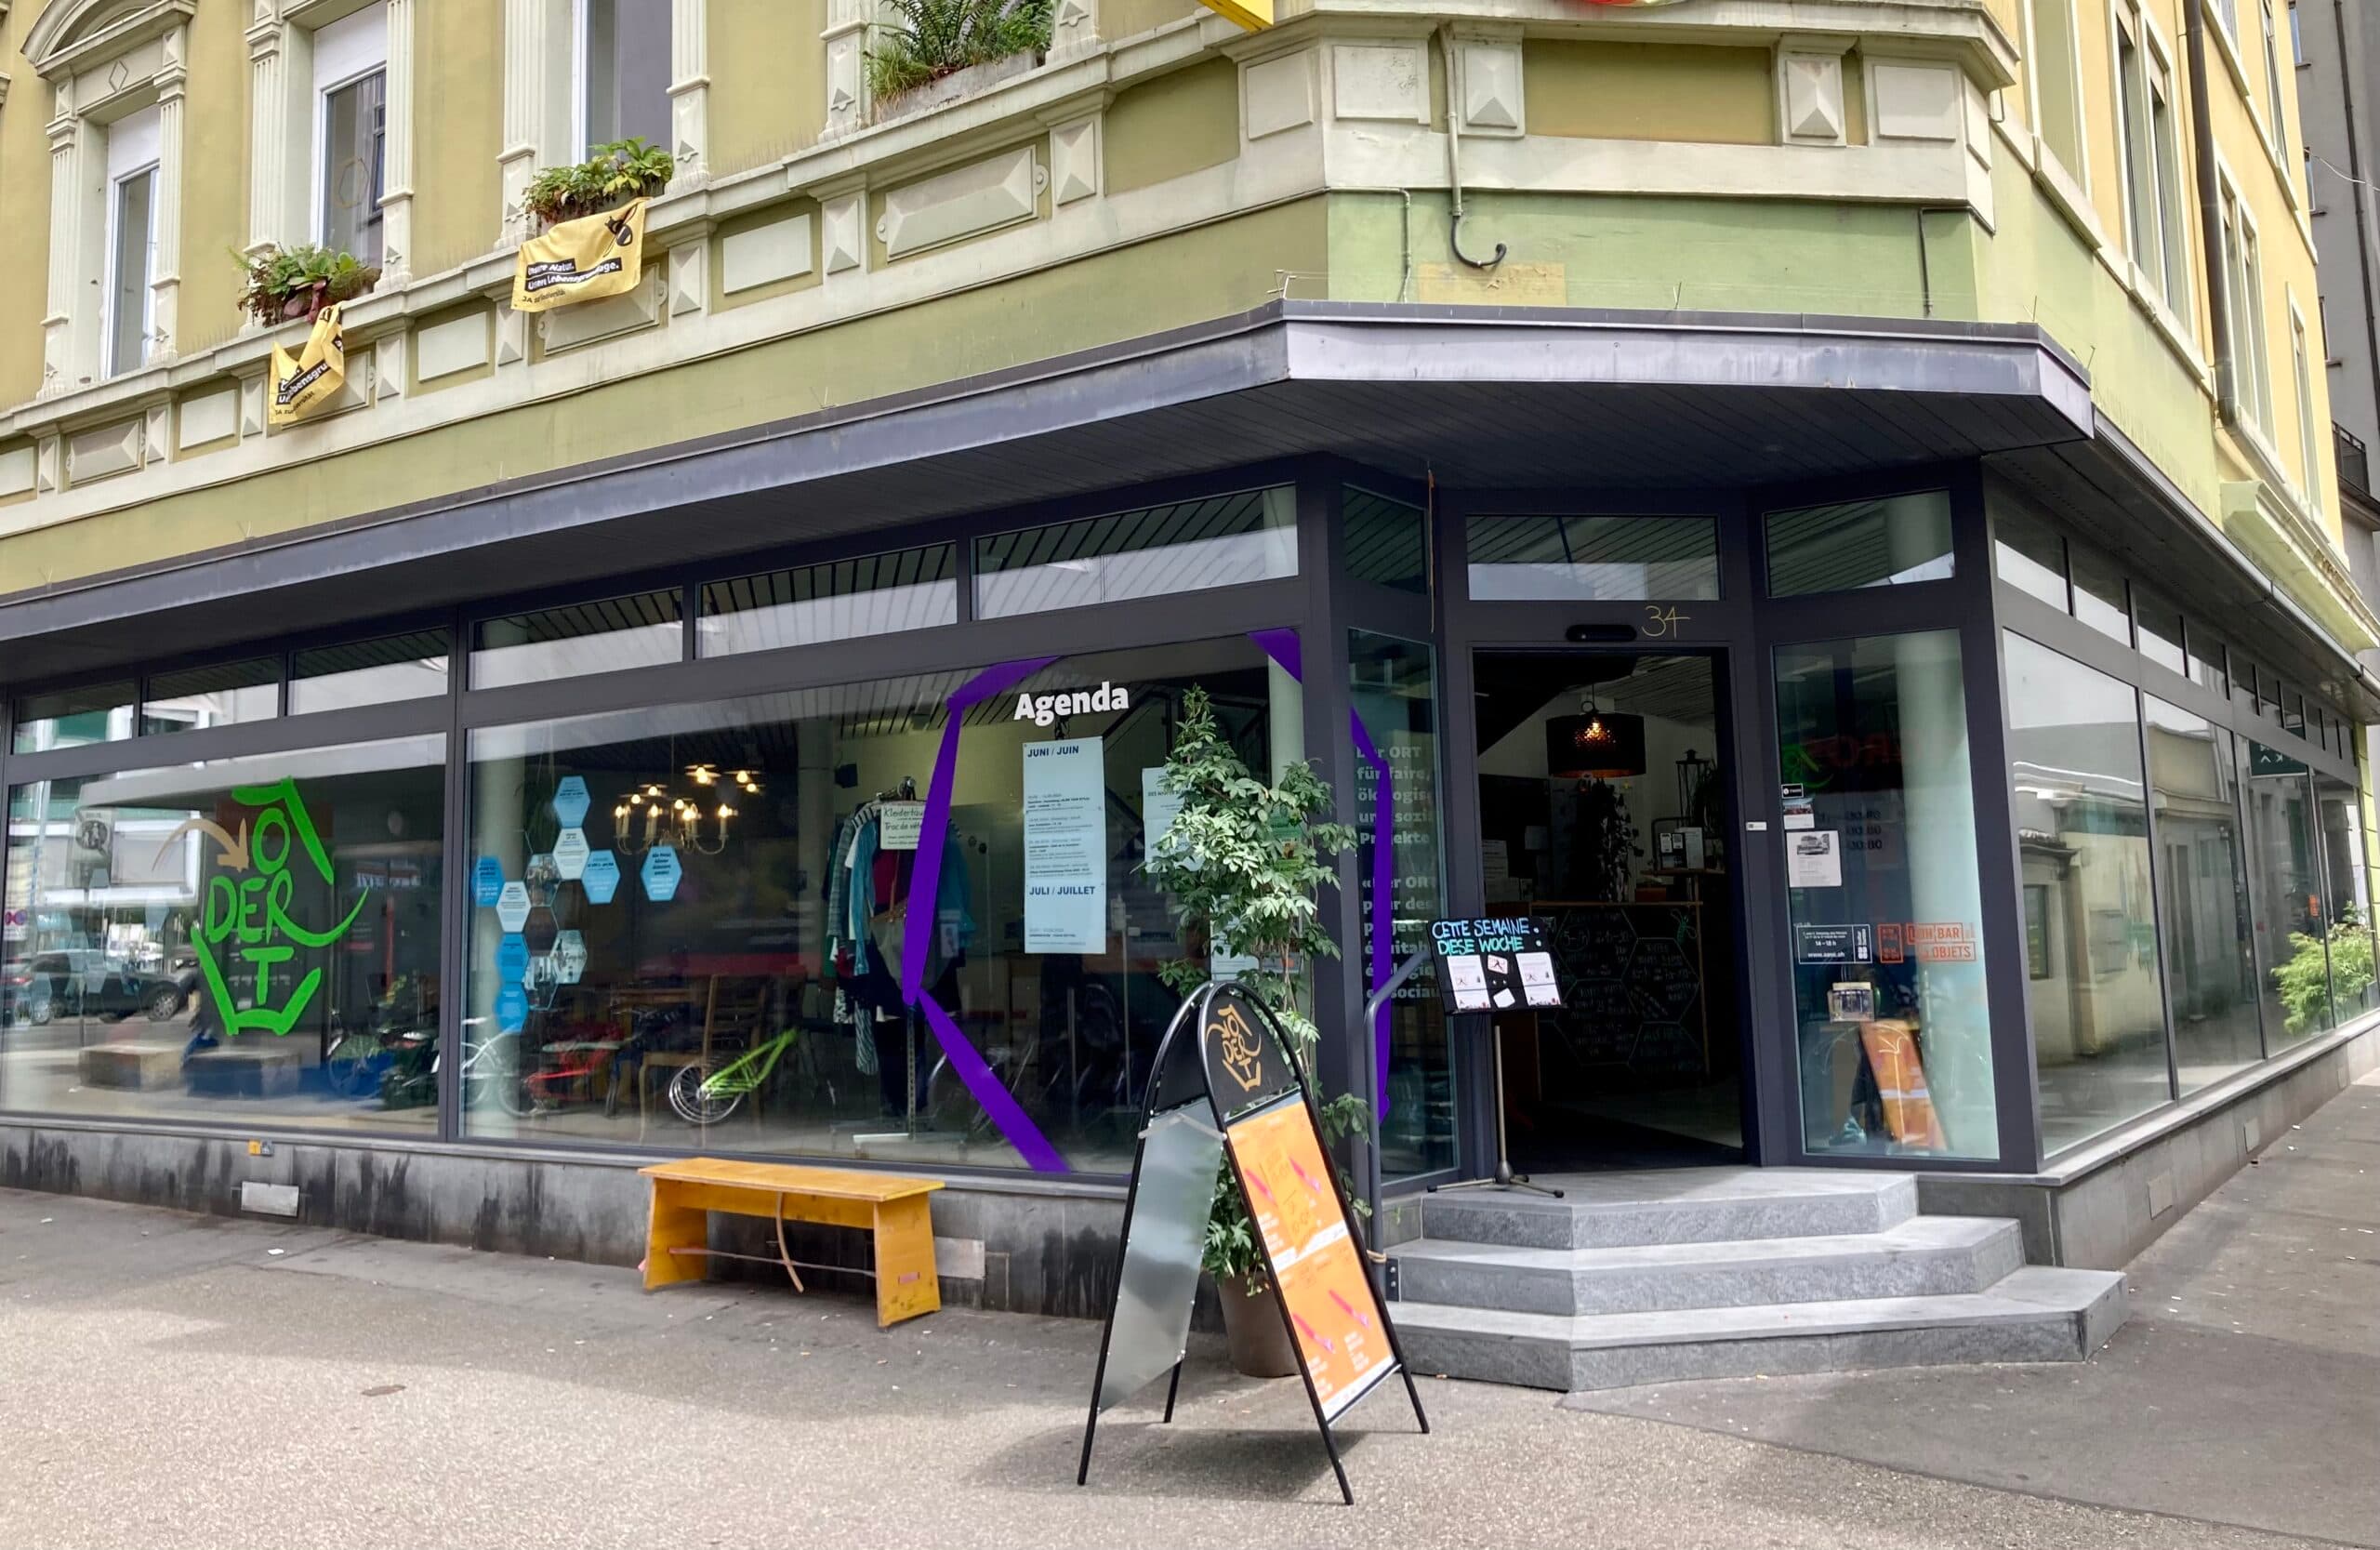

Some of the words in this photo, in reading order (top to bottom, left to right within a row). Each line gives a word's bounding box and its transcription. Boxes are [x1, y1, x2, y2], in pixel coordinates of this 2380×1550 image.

[1642, 605, 1691, 639] 34
[1013, 681, 1130, 727] Agenda
[1027, 748, 1050, 758] JUNI
[1056, 746, 1079, 756] JUIN
[1389, 747, 1421, 758] ORT
[1029, 886, 1050, 895] JULI
[1057, 885, 1095, 895] JUILLET
[1432, 920, 1471, 939] CETTE
[1474, 917, 1530, 937] SEMAINE
[1937, 927, 1960, 939] BAR
[1437, 938, 1475, 956] DIESE
[1479, 935, 1525, 953] WOCHE
[1933, 946, 1971, 959] OBJETS
